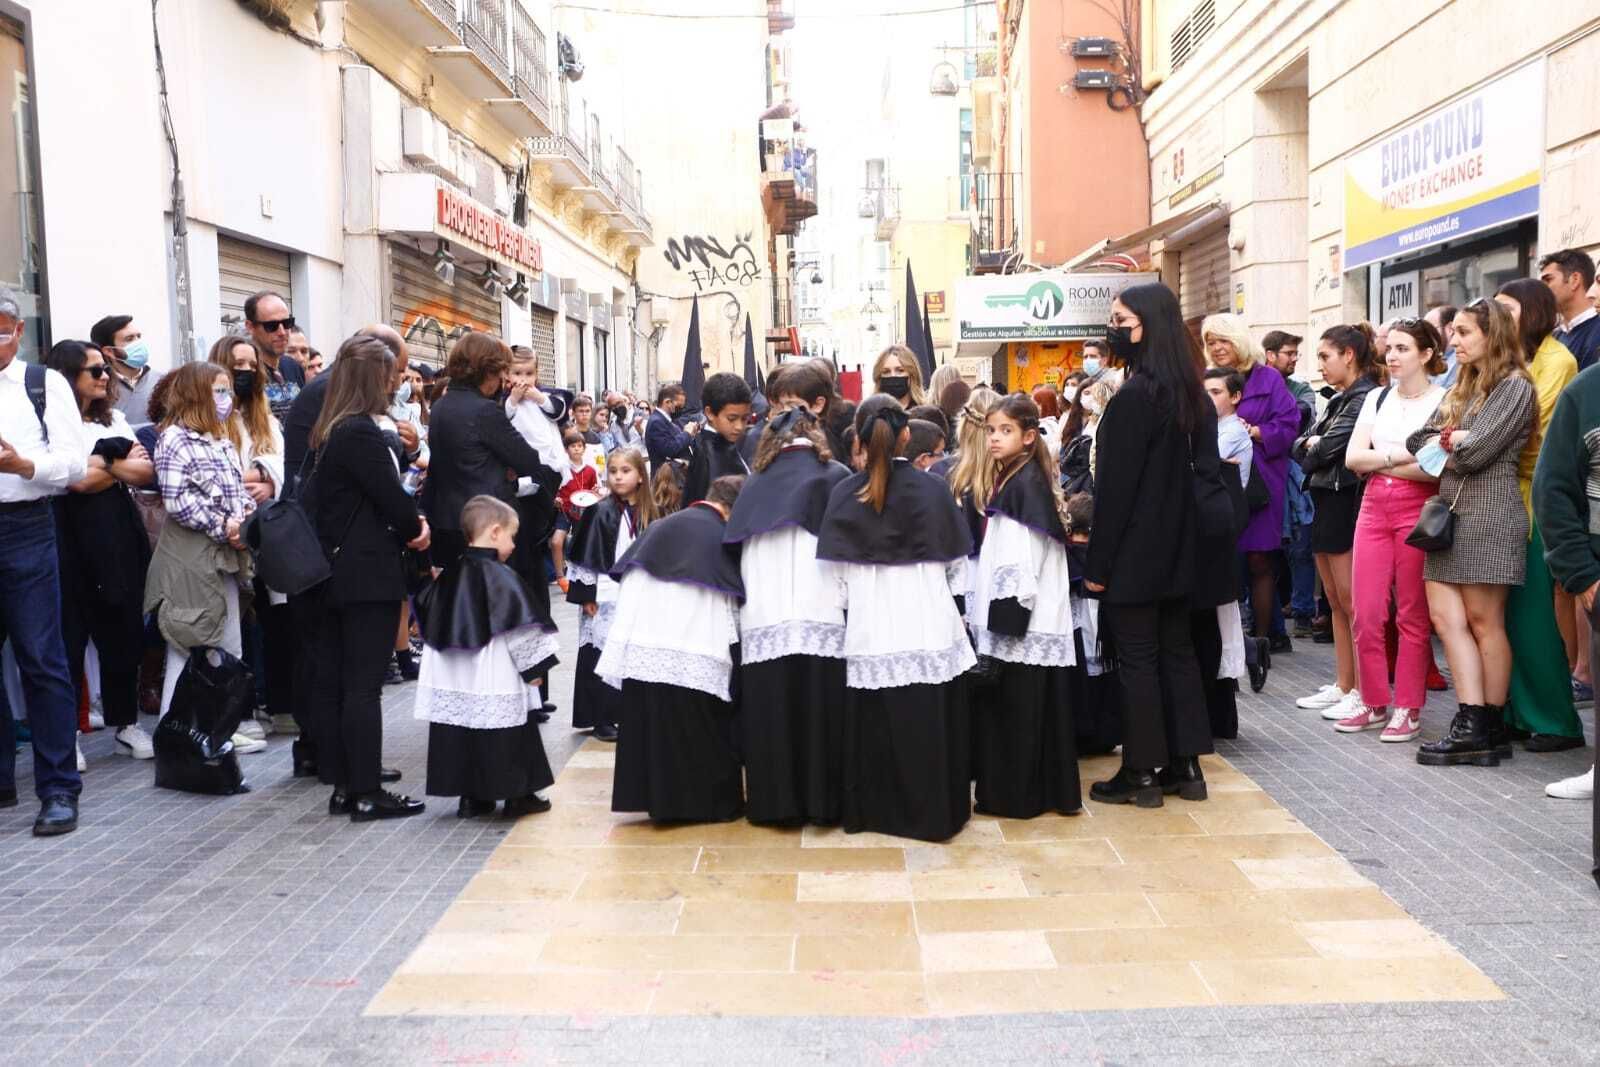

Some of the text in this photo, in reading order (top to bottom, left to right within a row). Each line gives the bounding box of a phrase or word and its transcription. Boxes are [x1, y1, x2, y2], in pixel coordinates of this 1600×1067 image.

[1382, 97, 1482, 188] EUROPOUND
[1381, 154, 1483, 213] MONEY EXCHANGE
[1398, 216, 1459, 247] www.europound.es
[1069, 287, 1110, 299] ROOM
[1389, 282, 1412, 310] ATM
[998, 329, 1021, 338] Alquiler
